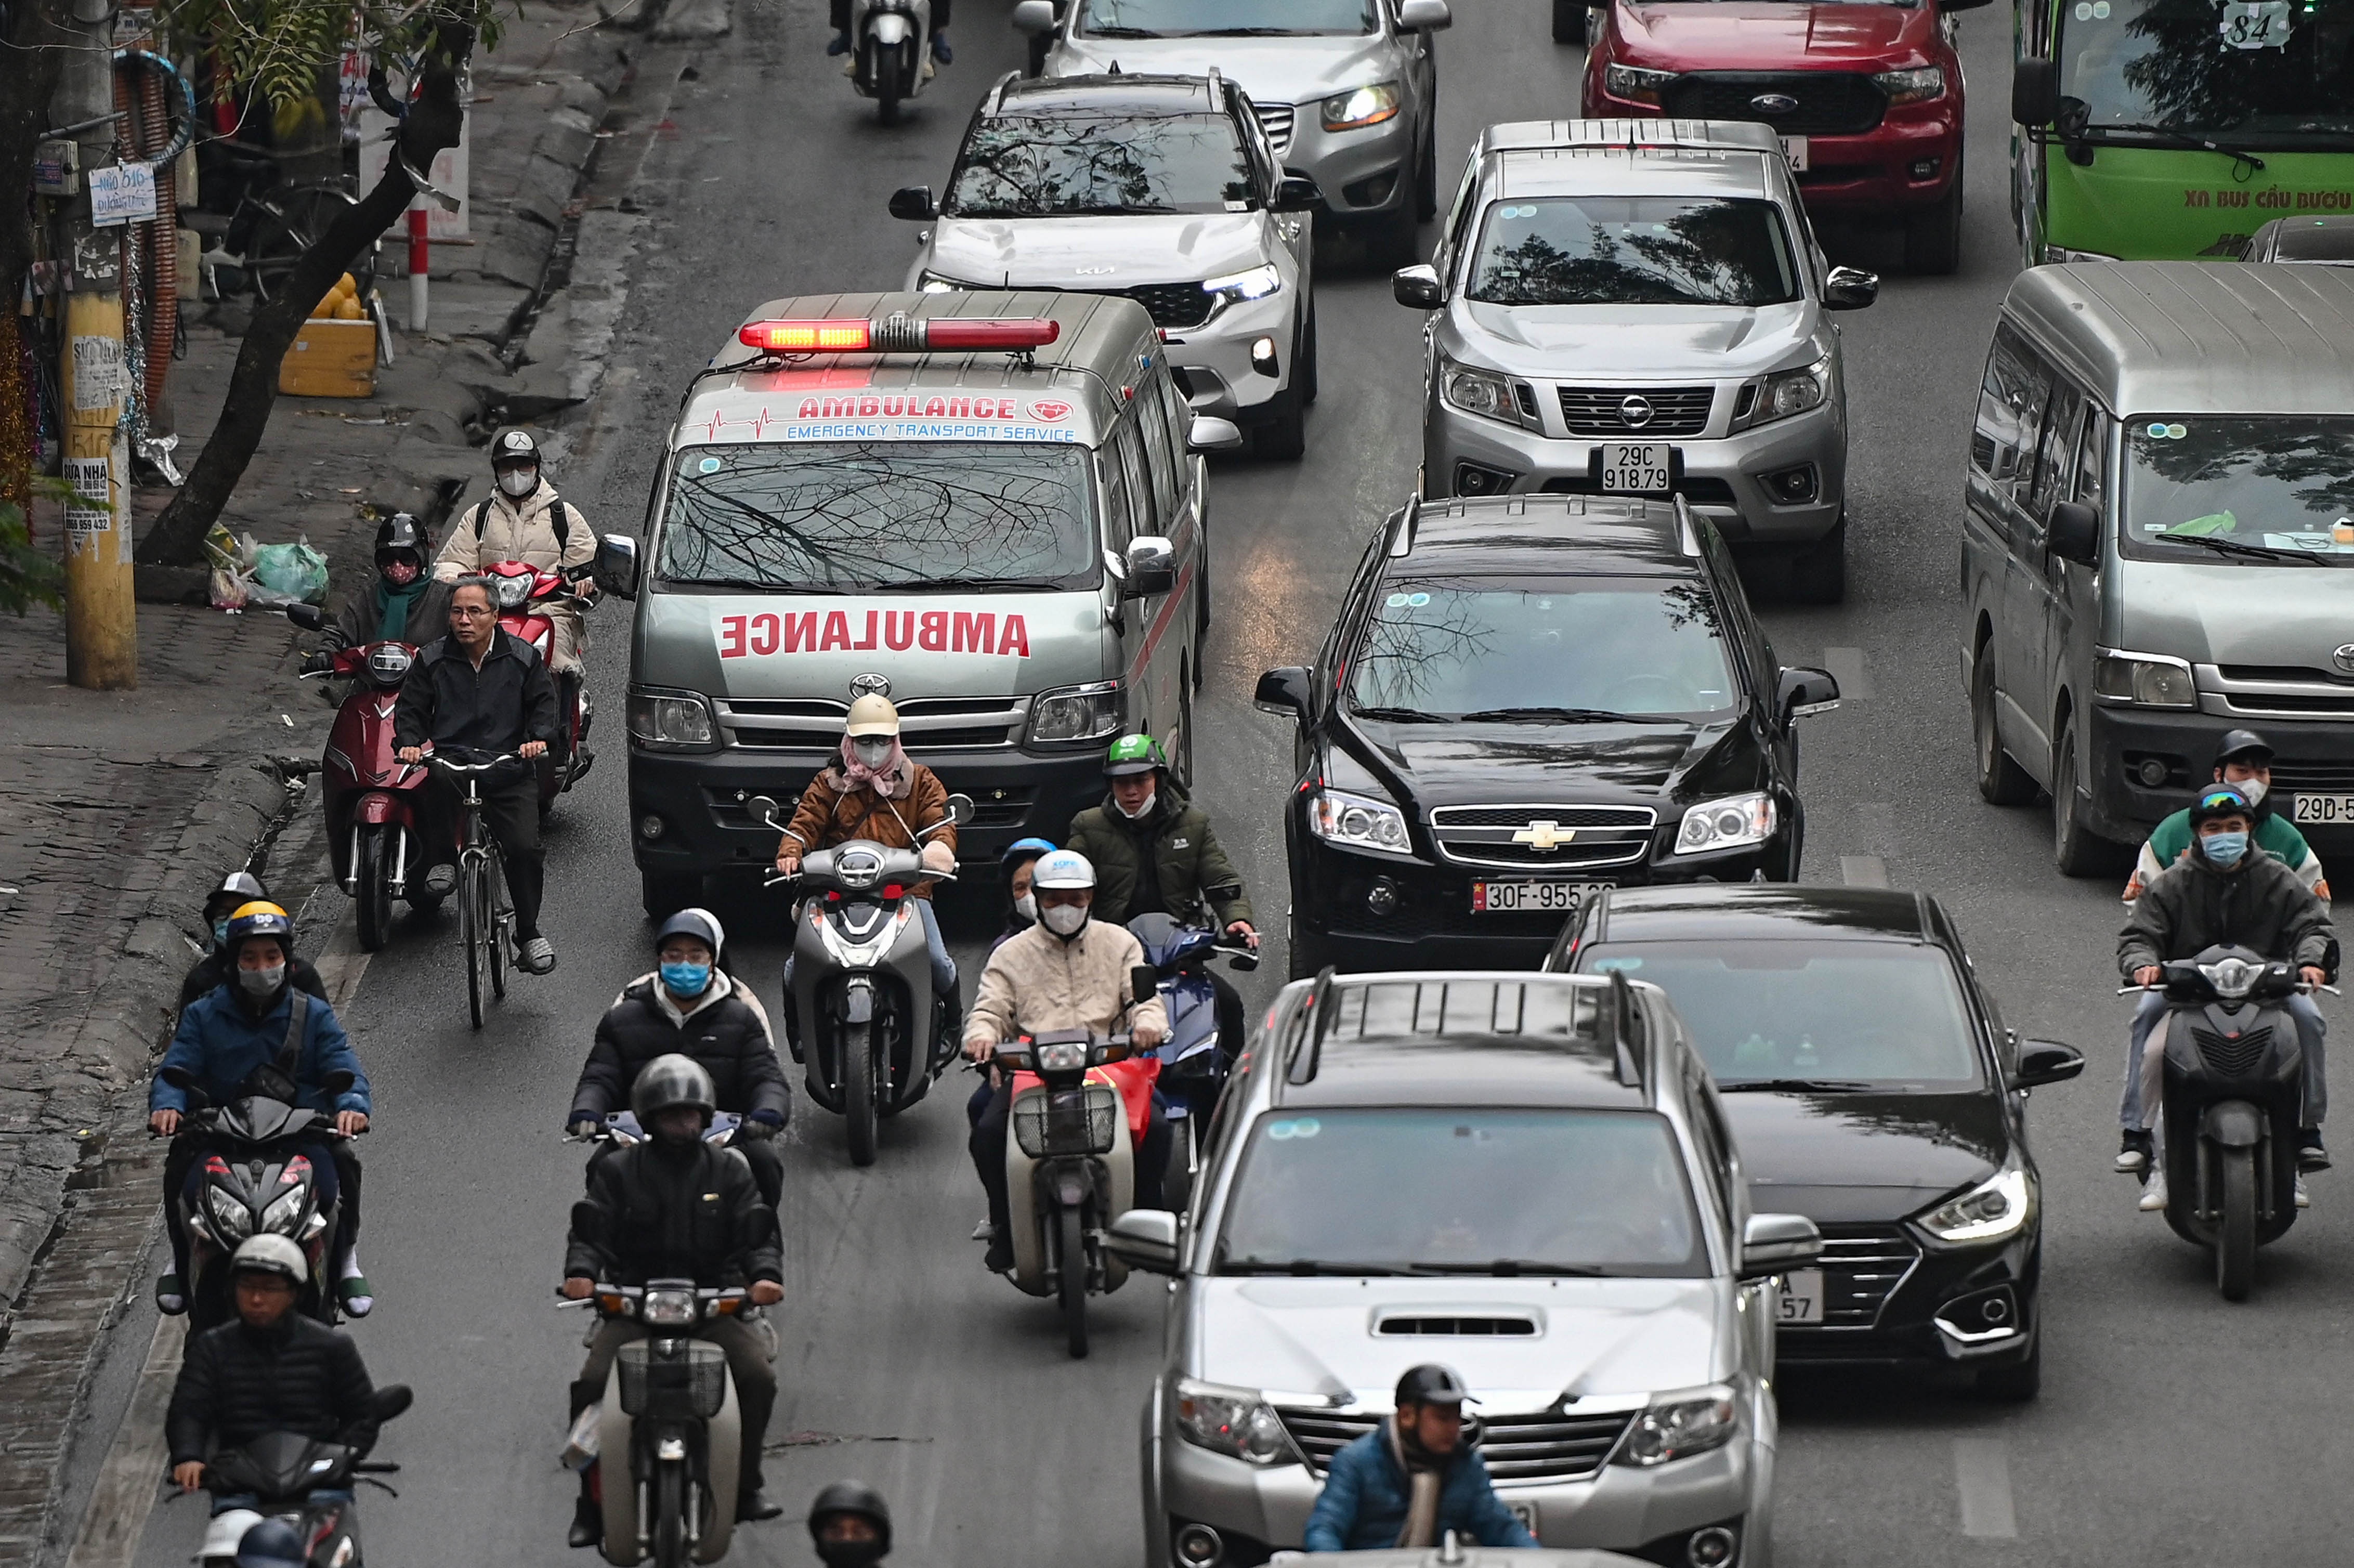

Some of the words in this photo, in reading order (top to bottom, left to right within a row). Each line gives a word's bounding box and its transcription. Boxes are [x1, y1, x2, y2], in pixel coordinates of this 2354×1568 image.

[2231, 15, 2271, 43] 84
[122, 167, 145, 188] 516
[2217, 190, 2250, 207] BUS
[799, 396, 1016, 420] AMBULANCE
[788, 424, 888, 439] EMERGENCY
[895, 424, 998, 439] TRANSPORT
[1003, 427, 1075, 442] SERVICE
[1619, 447, 1653, 466] 29C
[1604, 469, 1667, 489] 918.79
[79, 519, 91, 530] 959
[94, 519, 108, 529] 432
